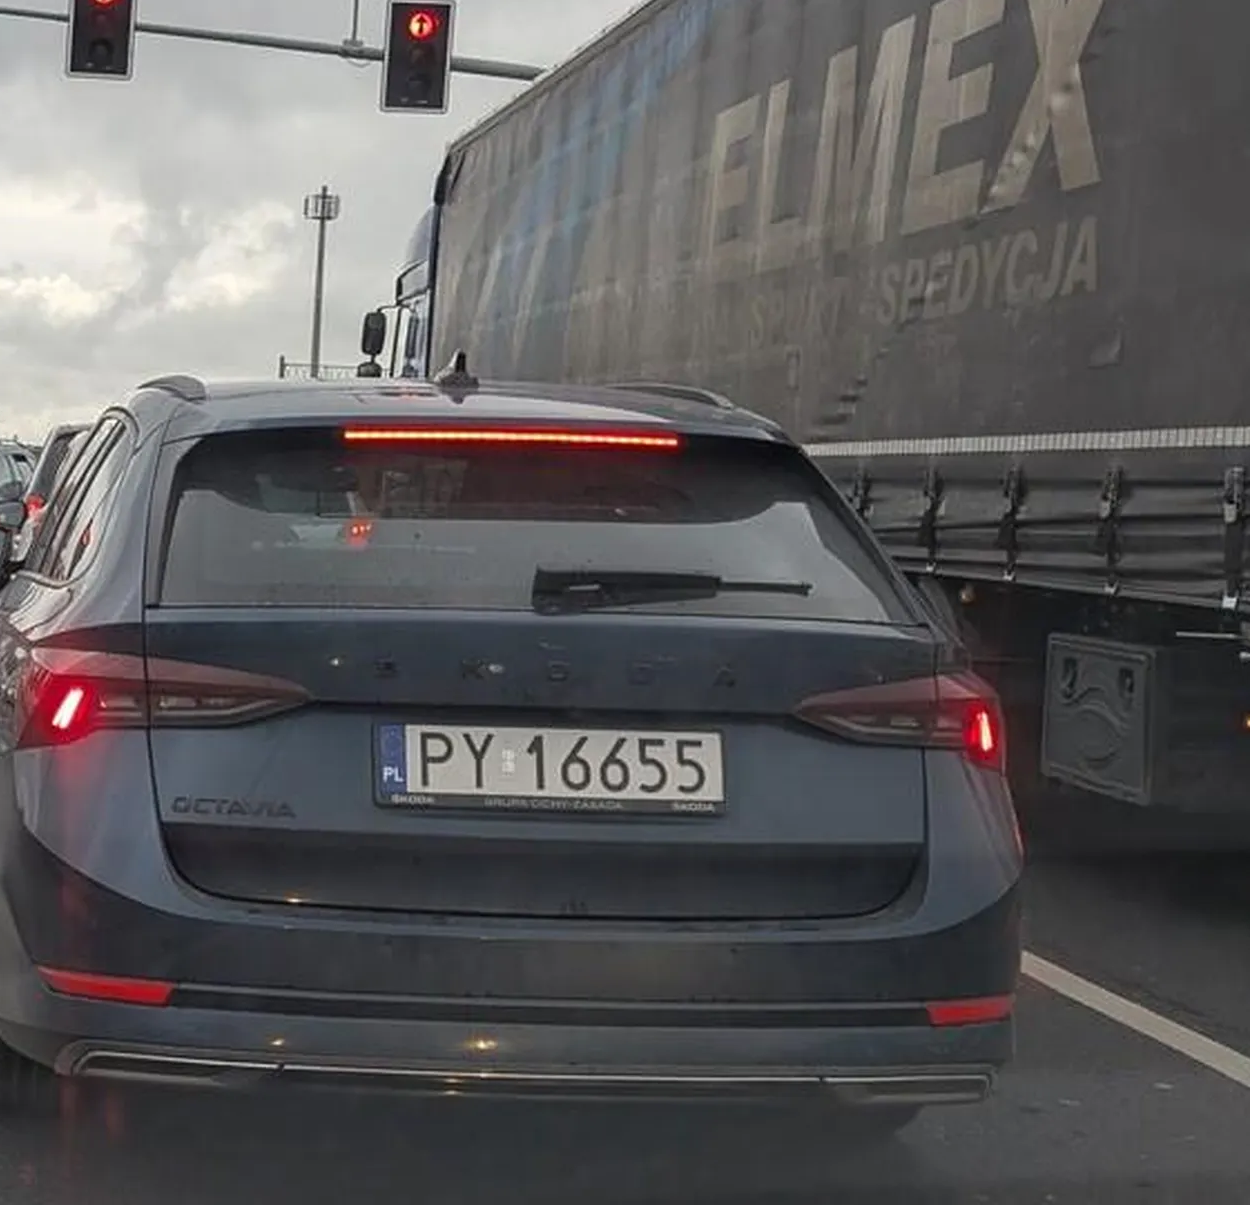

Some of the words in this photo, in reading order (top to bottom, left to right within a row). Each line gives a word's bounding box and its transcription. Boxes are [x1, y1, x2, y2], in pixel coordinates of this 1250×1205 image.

[876, 215, 1098, 326] SPEDYCJA
[383, 766, 405, 783] PL
[419, 731, 495, 789] PY
[526, 734, 706, 793] 16655
[169, 796, 297, 819] OCTAVIA
